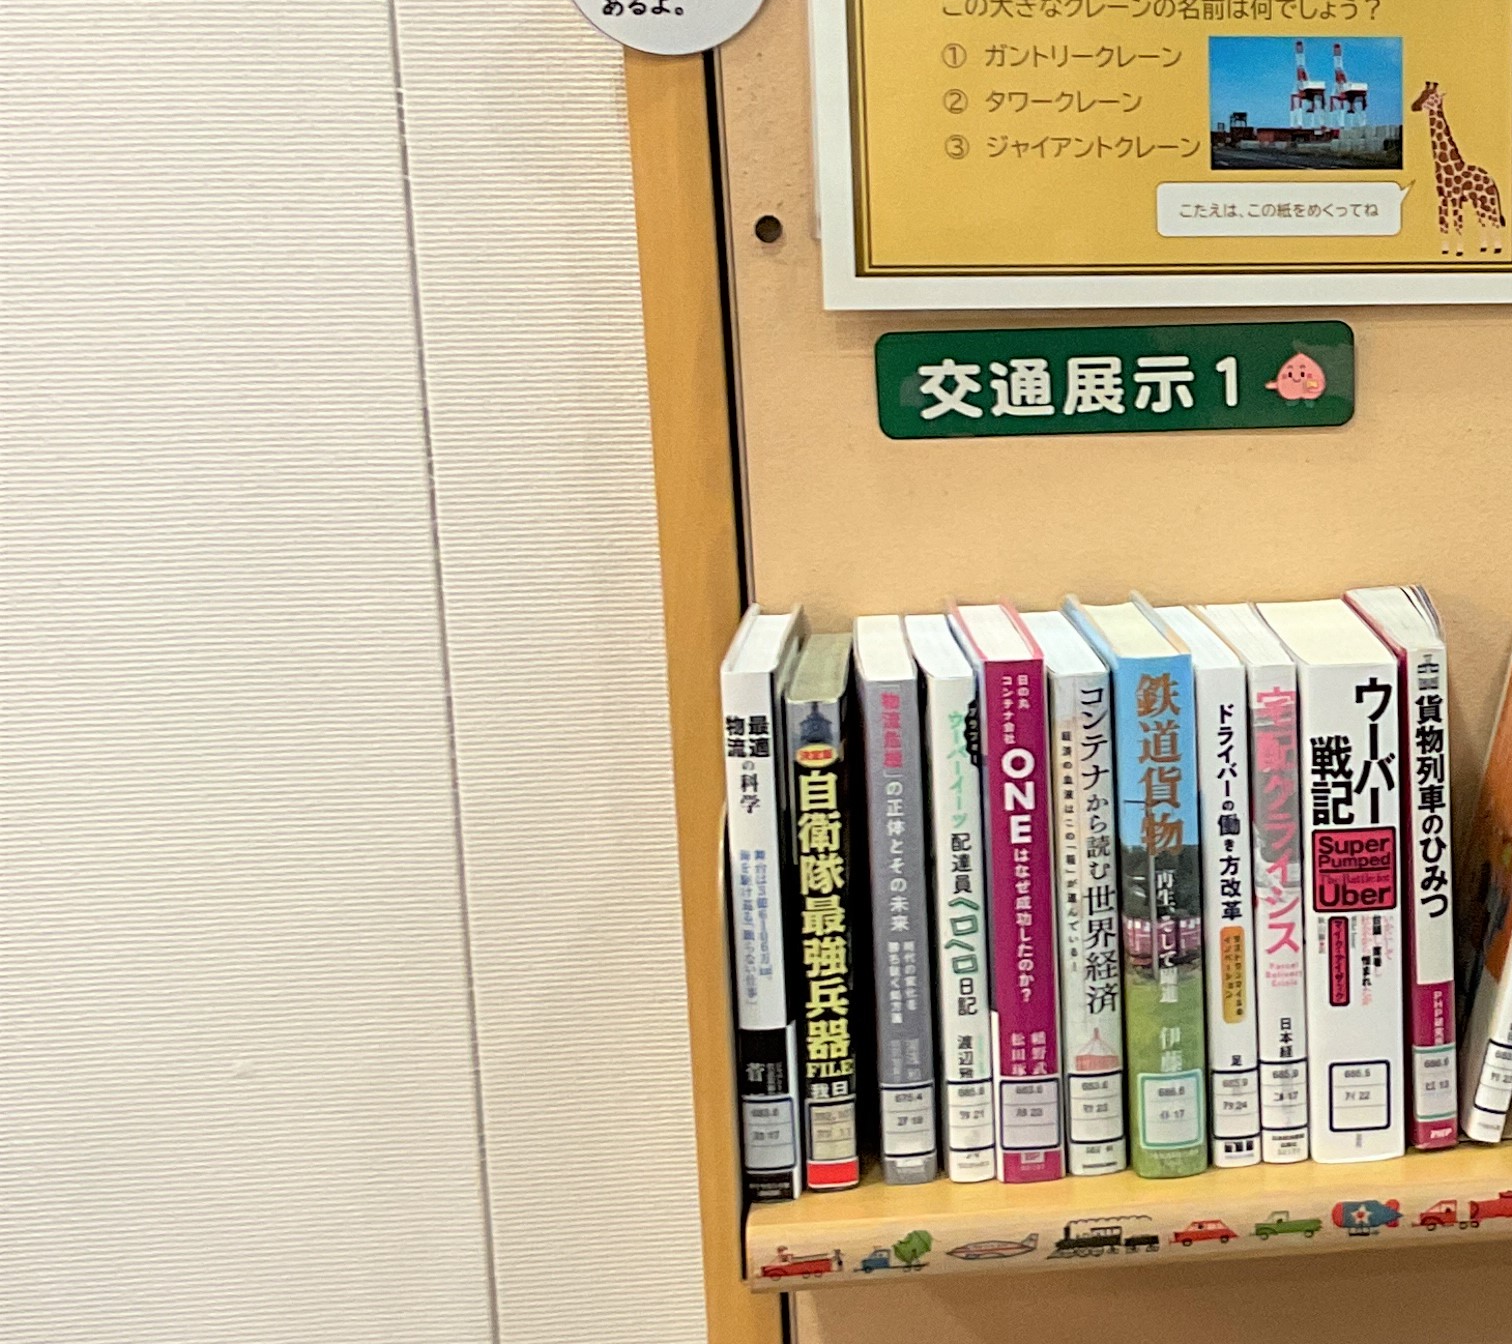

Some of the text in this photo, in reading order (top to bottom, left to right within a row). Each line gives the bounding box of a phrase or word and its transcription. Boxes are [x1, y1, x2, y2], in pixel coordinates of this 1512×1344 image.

[983, 43, 1183, 69] ガントリークレーン
[986, 89, 1143, 115] タワークレーン
[986, 134, 1201, 161] ジャイアントクレーン
[1178, 200, 1380, 221] こたえは、この紙をめくってね
[1134, 672, 1185, 857] 鉄道貨物
[1309, 734, 1356, 827] 戦記
[1353, 676, 1397, 825] ウーバー
[1079, 686, 1120, 1016] コンテナから読む世界経済
[1215, 703, 1244, 921] ドライバーの働き方改革
[1255, 685, 1301, 955] 宅配クライシス
[1318, 835, 1392, 857] Super
[1414, 692, 1449, 918] 貨物列車のひみつ
[1318, 851, 1392, 869] Pumped
[1318, 883, 1392, 907] Uber
[797, 770, 854, 1078] 自衛隊最強兵器 FILE
